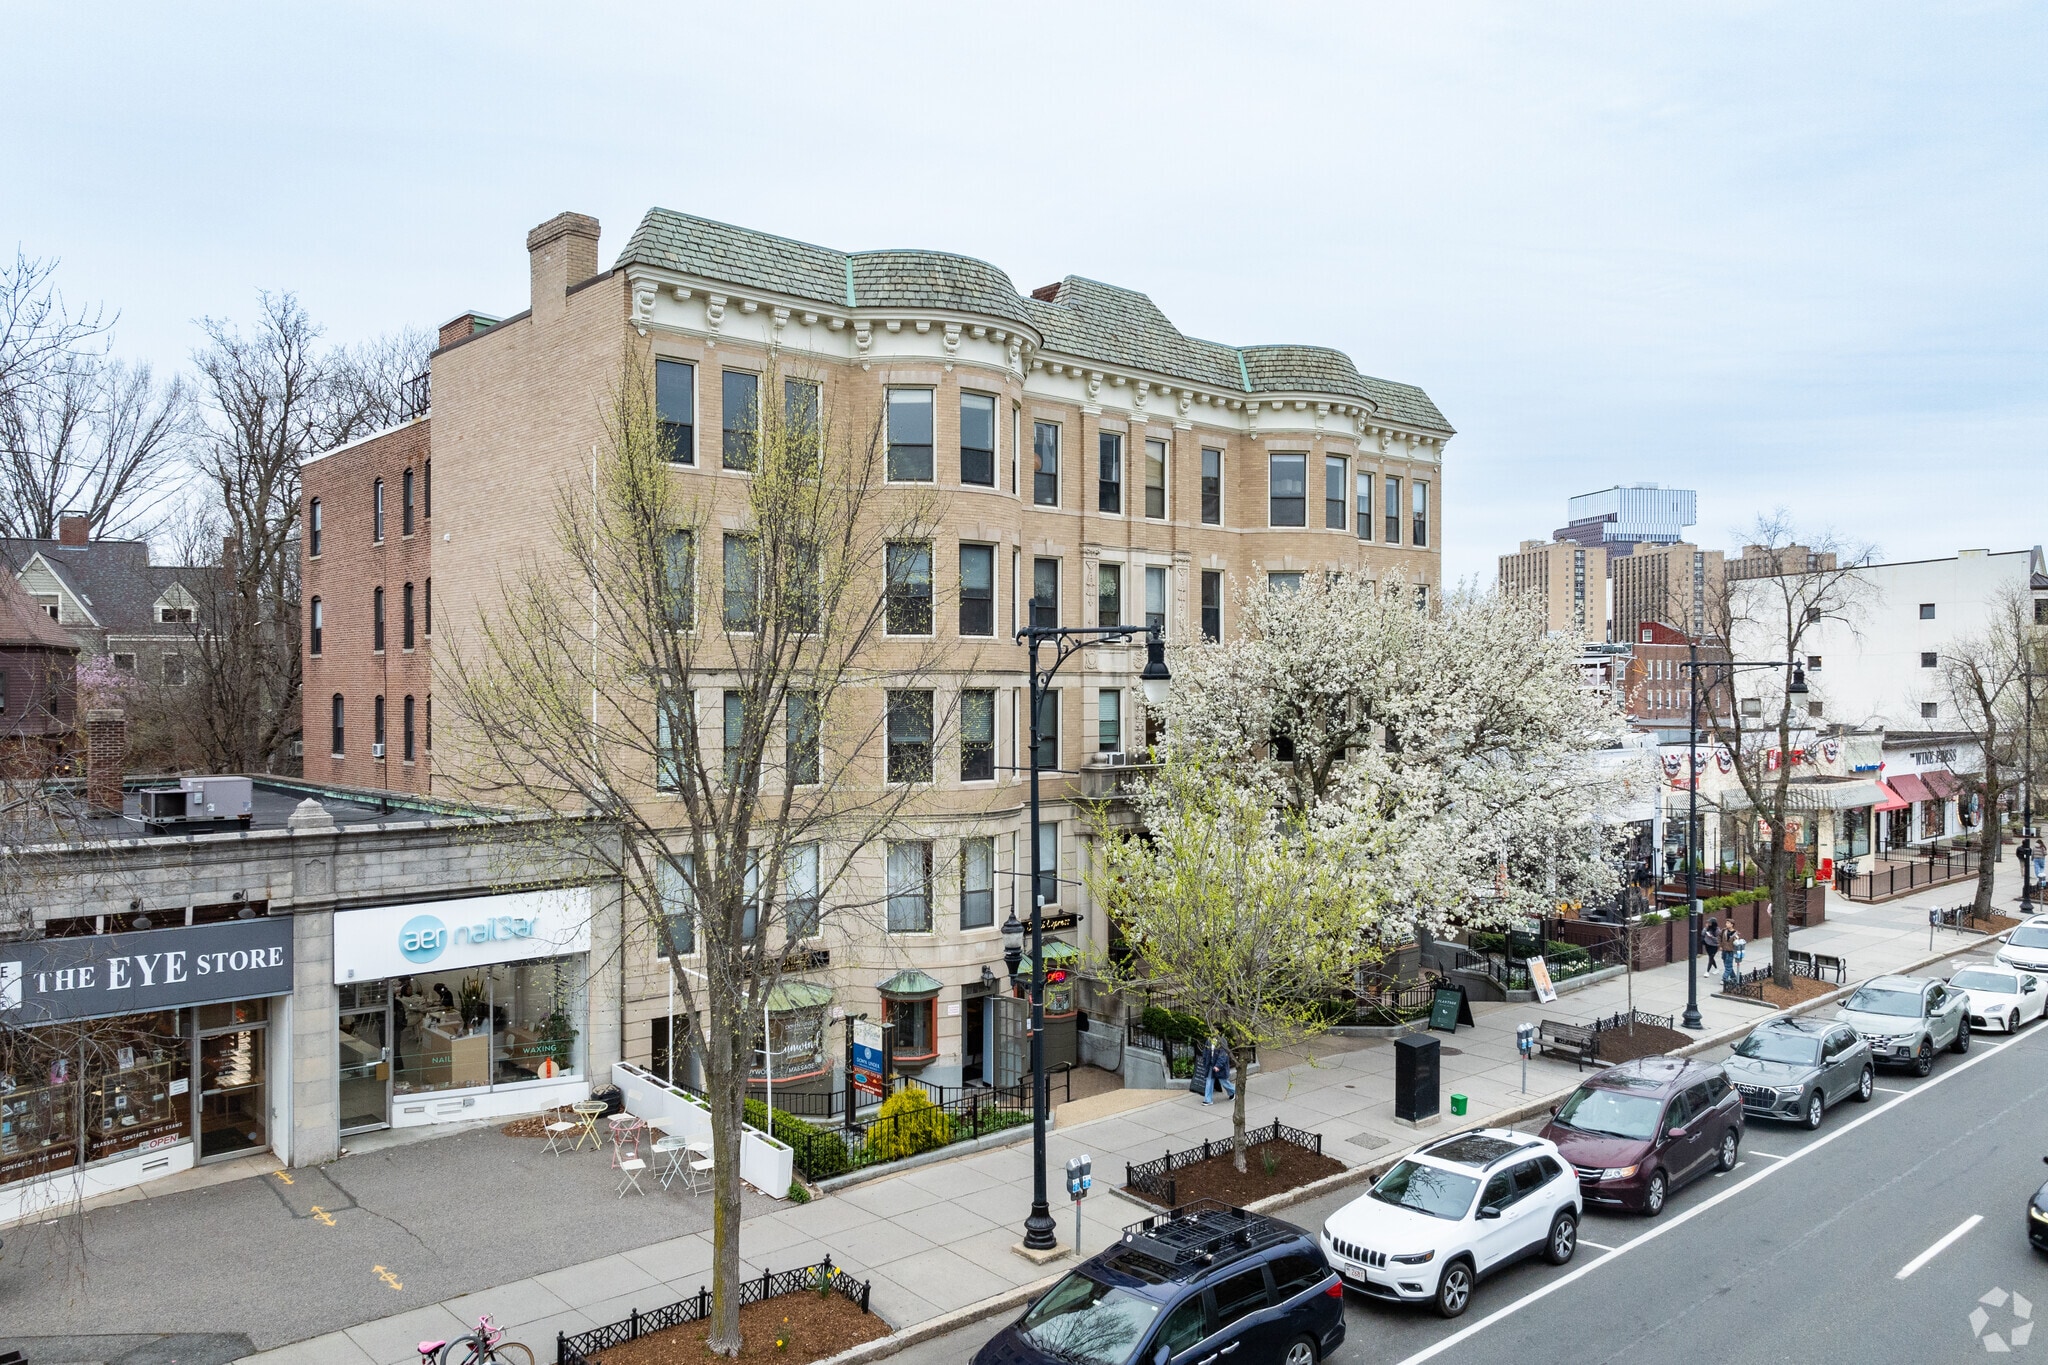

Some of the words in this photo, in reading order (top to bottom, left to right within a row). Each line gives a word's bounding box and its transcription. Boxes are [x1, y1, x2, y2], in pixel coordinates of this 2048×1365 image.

[1915, 750, 1934, 765] WINE
[403, 928, 445, 951] aer
[33, 966, 96, 994] THE
[106, 950, 188, 991] EYE
[196, 947, 284, 976] STORE
[1047, 971, 1066, 982] OPEN
[522, 1044, 557, 1054] WAXING
[788, 1062, 815, 1073] MASSAGE
[92, 1138, 118, 1150] GLASSES
[121, 1130, 149, 1142] CONTACTS
[165, 1122, 183, 1132] EXAMS
[149, 1134, 177, 1149] OPEN
[1, 1160, 33, 1172] CONTACTS
[38, 1155, 50, 1163] EYE
[51, 1150, 72, 1160] EXAMS
